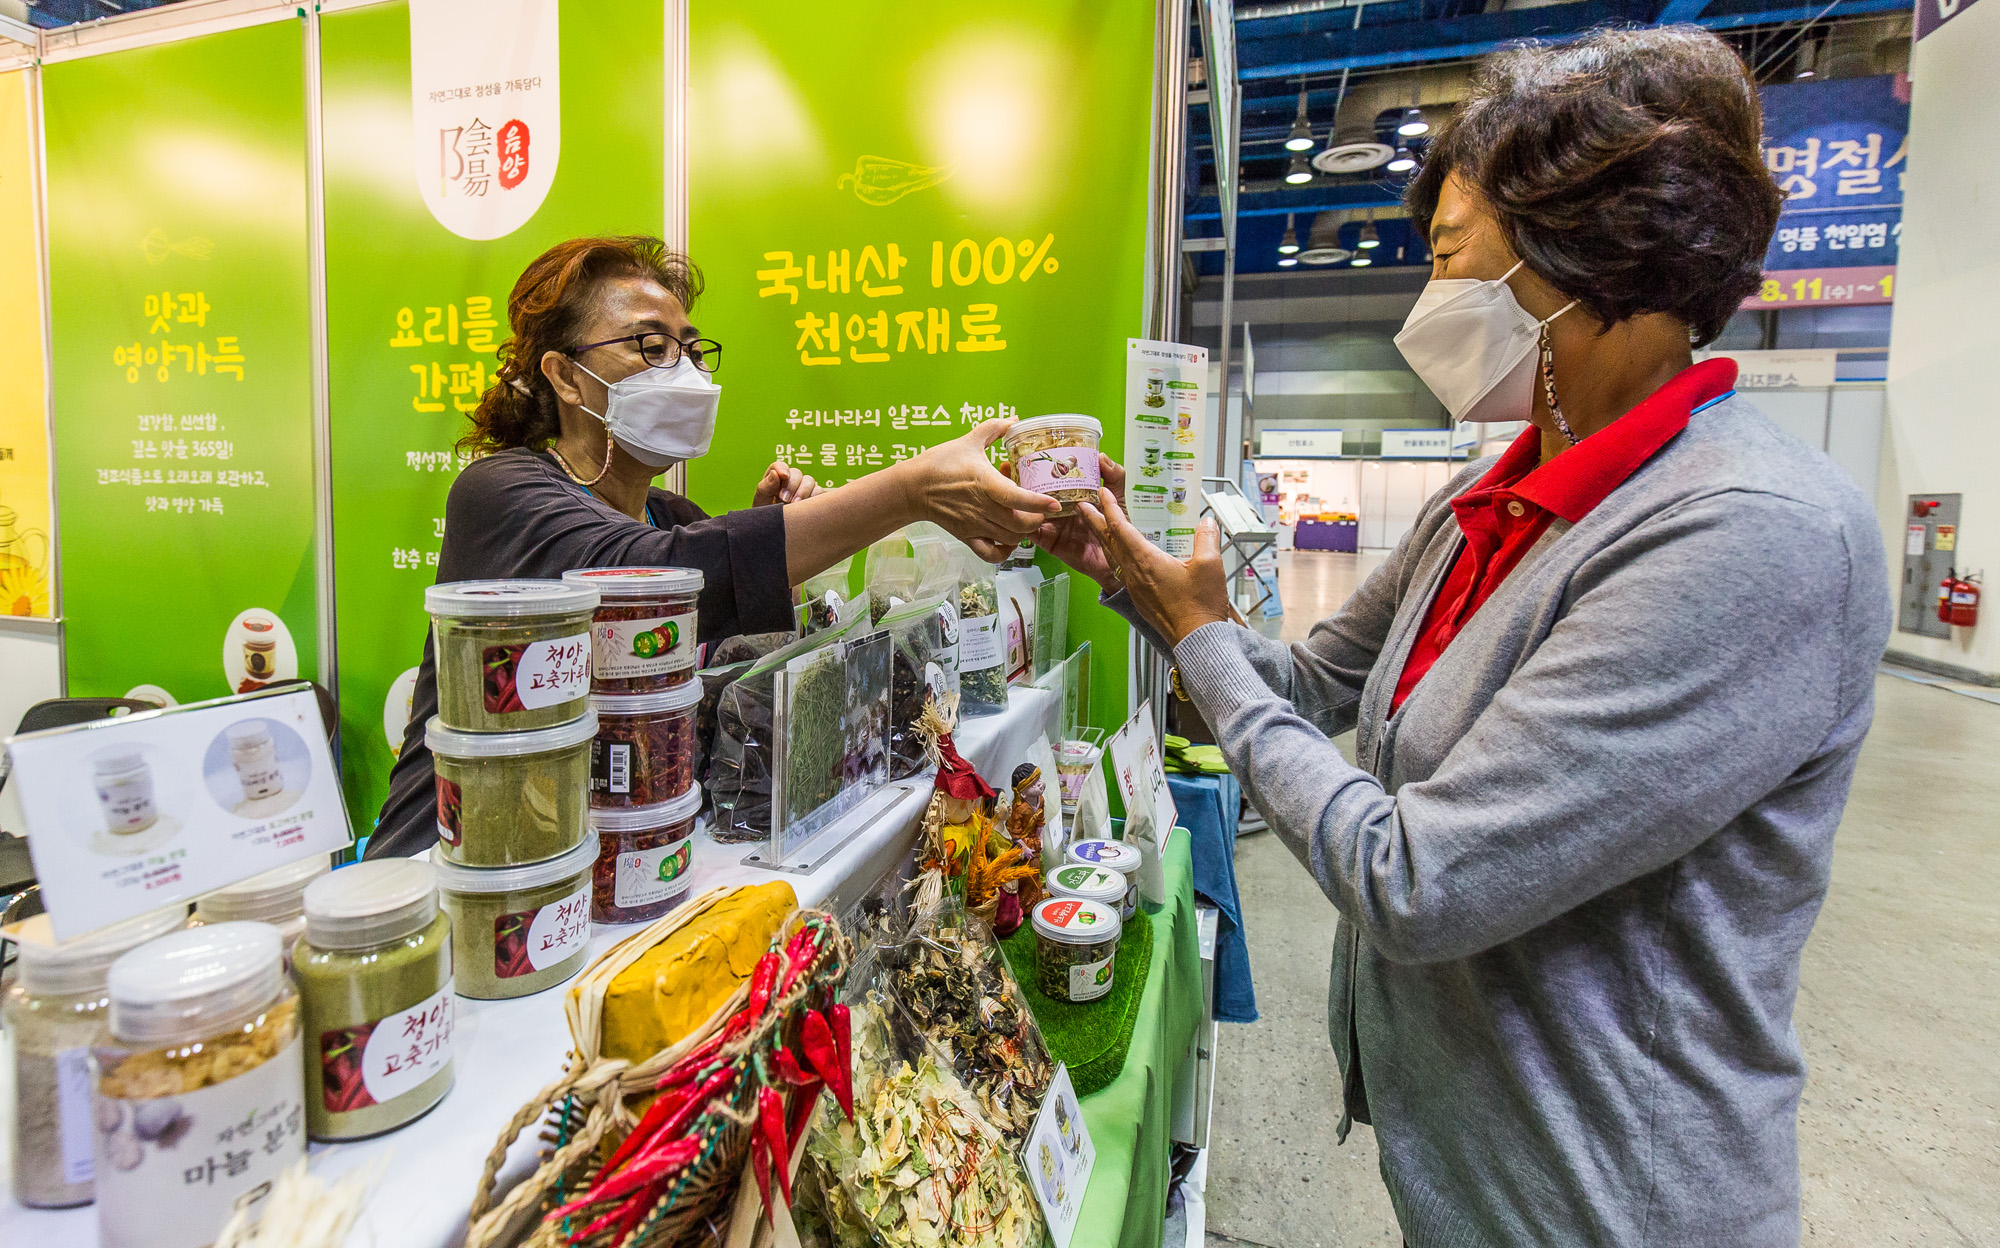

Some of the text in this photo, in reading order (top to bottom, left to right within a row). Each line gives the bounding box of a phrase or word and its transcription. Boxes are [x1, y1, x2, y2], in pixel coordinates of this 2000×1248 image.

[428, 76, 542, 103] 자연그대로 정성을 가득담다
[1777, 226, 1820, 253] 명품
[1824, 222, 1887, 250] 천일염
[756, 232, 1060, 304] 국내산 100%
[144, 291, 211, 334] 맛과
[389, 296, 499, 353] 요리를
[795, 303, 1007, 366] 천연재료
[113, 336, 245, 383] 영양가득
[409, 361, 505, 412] 간편
[138, 414, 178, 431] 건강함,
[785, 408, 881, 430] 우리나라의
[888, 403, 952, 430] 알프스
[132, 439, 234, 459] 깊은 맛을 365일!
[406, 451, 451, 472] 정성껏
[775, 444, 813, 466] 맑은
[820, 444, 838, 466] 물
[846, 444, 883, 466] 맑은
[97, 468, 269, 488] 건조식품으로 오래오래 보관하고,
[145, 496, 224, 515] 맛과 영양 가득
[392, 547, 421, 570] 한층
[545, 641, 583, 669] 청양
[530, 664, 584, 690] 고춧가루
[555, 893, 587, 926] 청양
[540, 913, 587, 951] 고춧가루
[401, 996, 449, 1041] 청양
[184, 1148, 254, 1185] 마늘
